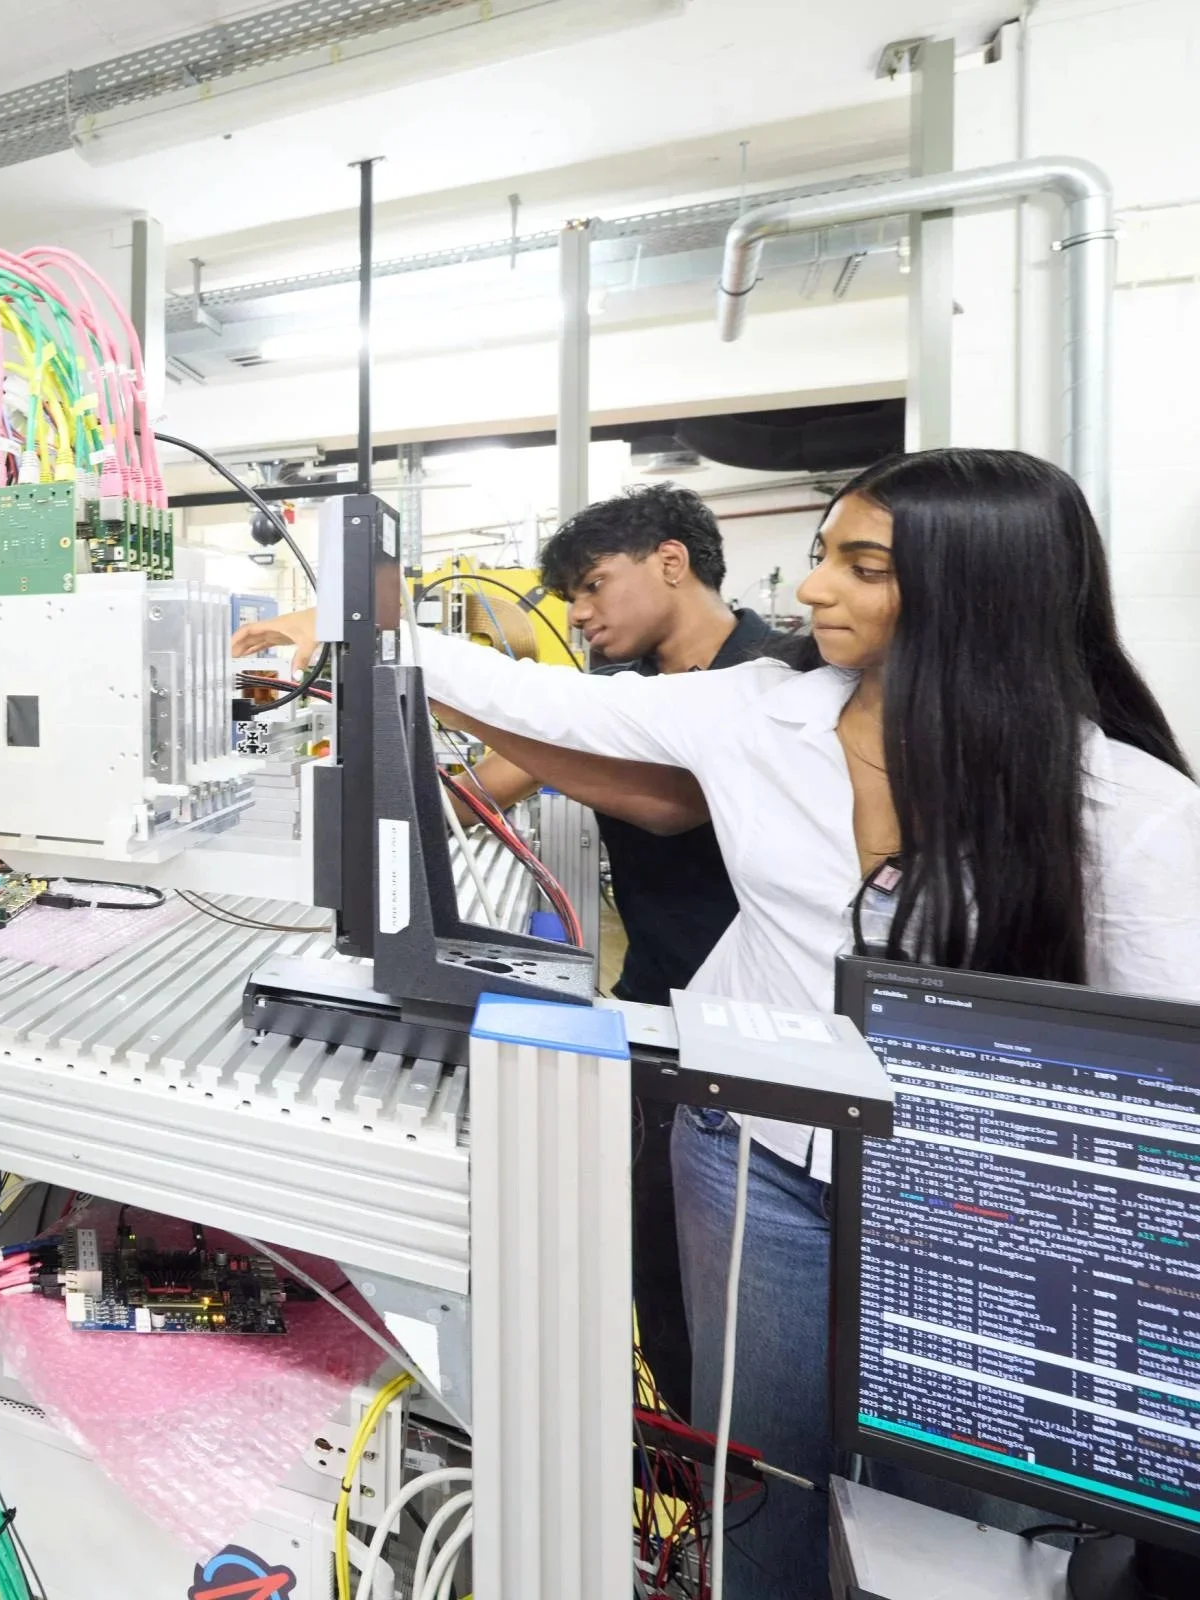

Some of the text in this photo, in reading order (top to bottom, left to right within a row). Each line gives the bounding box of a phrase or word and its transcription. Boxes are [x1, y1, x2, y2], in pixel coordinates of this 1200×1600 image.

[1137, 1154, 1182, 1170] Starting
[1137, 1192, 1183, 1209] Creating
[871, 1211, 890, 1222] from
[1030, 1219, 1062, 1231] python
[1138, 1397, 1184, 1418] Starting
[1138, 1426, 1184, 1448] Creating
